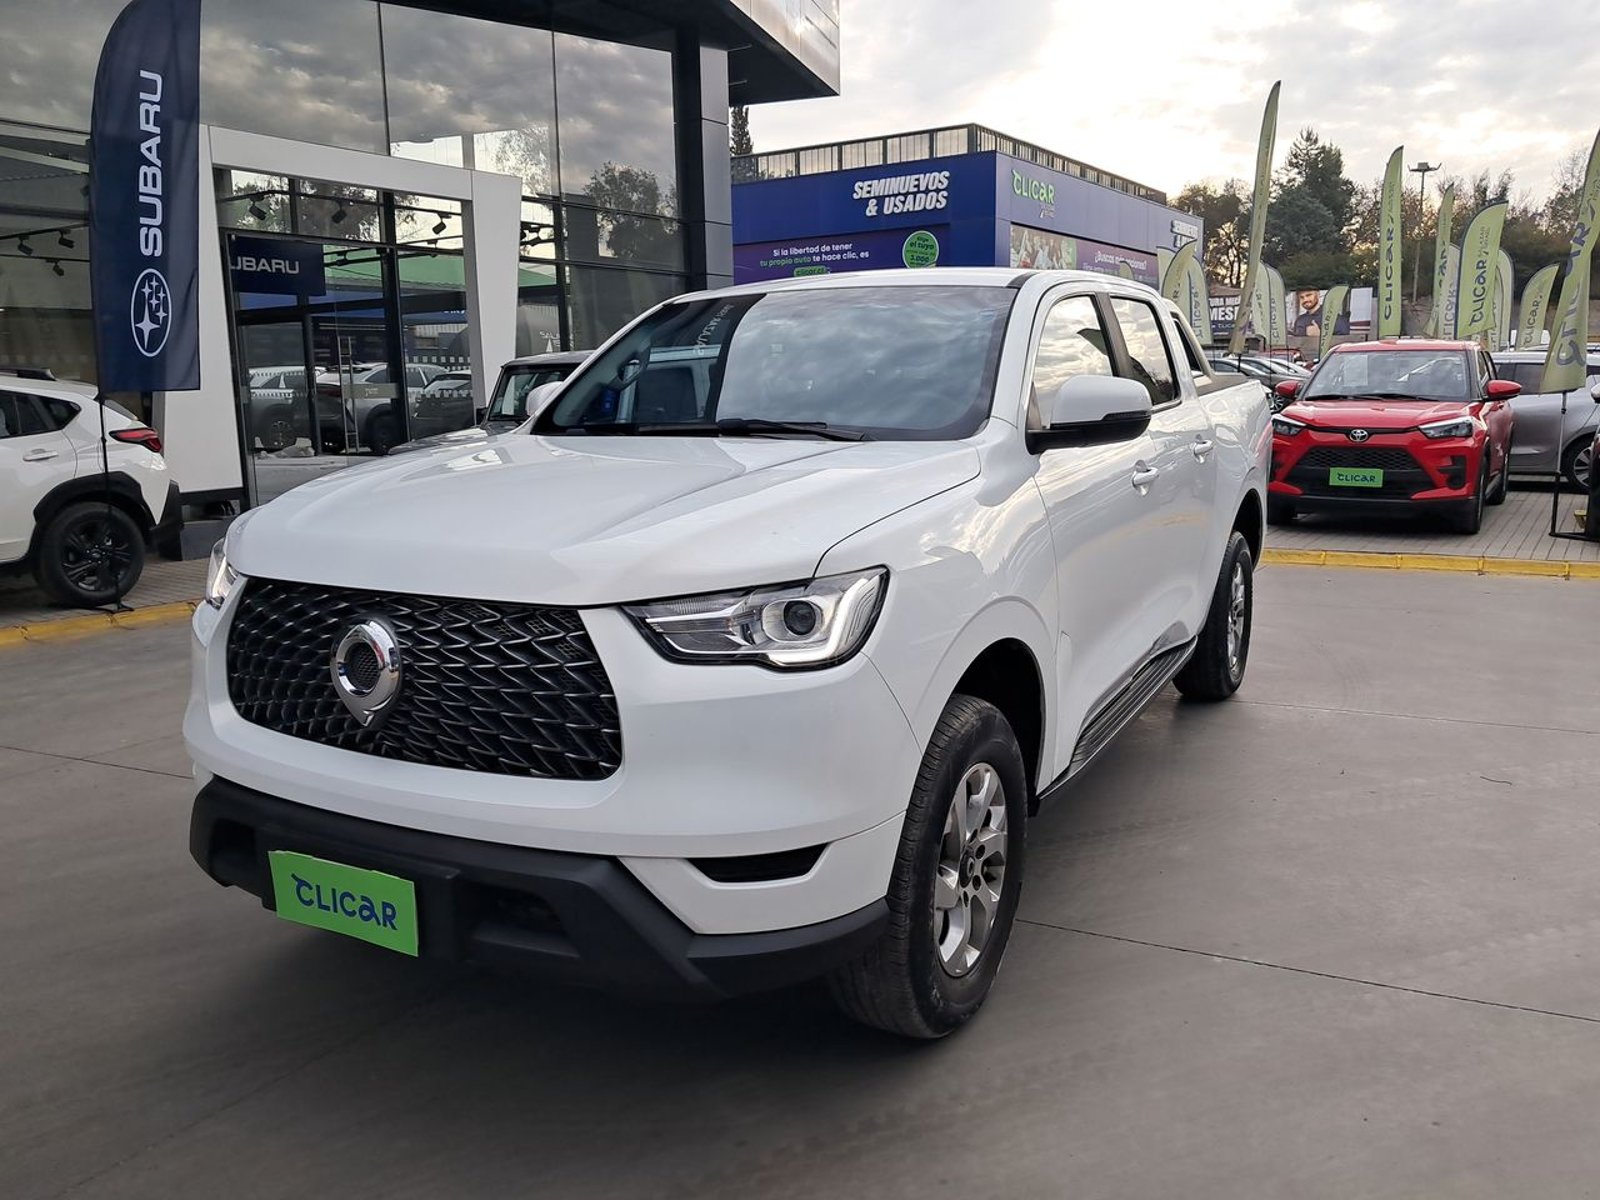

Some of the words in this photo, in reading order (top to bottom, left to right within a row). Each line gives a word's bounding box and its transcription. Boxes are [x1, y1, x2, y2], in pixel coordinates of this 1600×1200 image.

[138, 69, 163, 258] SUBARU
[852, 170, 950, 200] SEMINUEVOS
[865, 198, 878, 217] &
[883, 190, 948, 215] USADOS
[821, 244, 831, 253] de
[832, 243, 853, 251] tener
[230, 255, 300, 275] UBARU
